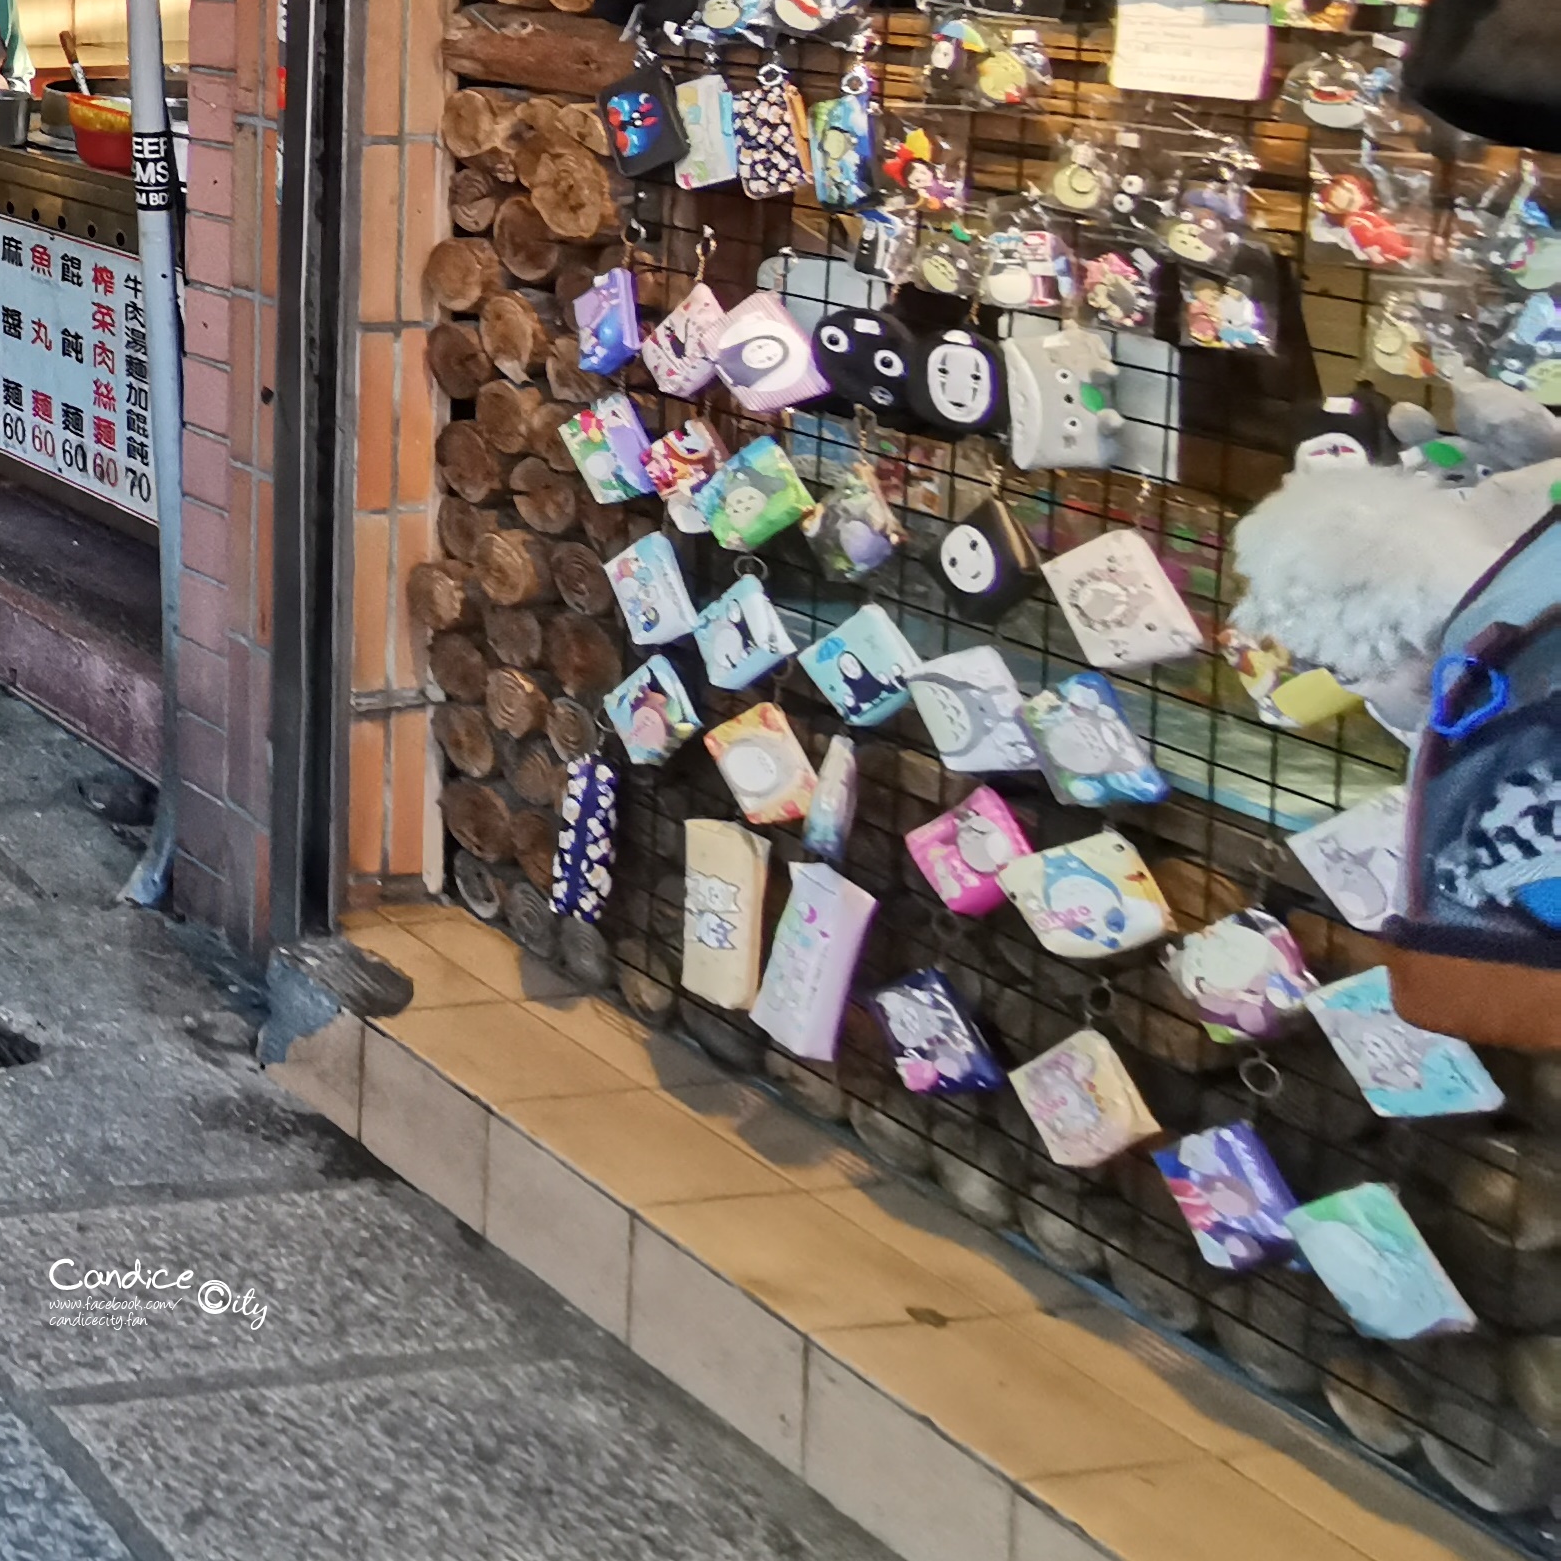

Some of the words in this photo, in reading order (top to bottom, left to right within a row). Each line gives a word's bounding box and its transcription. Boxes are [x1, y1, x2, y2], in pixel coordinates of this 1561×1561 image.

[29, 243, 54, 426] 魚丸麵
[1, 415, 27, 446] 60
[30, 430, 57, 459] 60
[61, 442, 88, 475] 60
[92, 451, 120, 488] 60
[124, 468, 152, 504] 70
